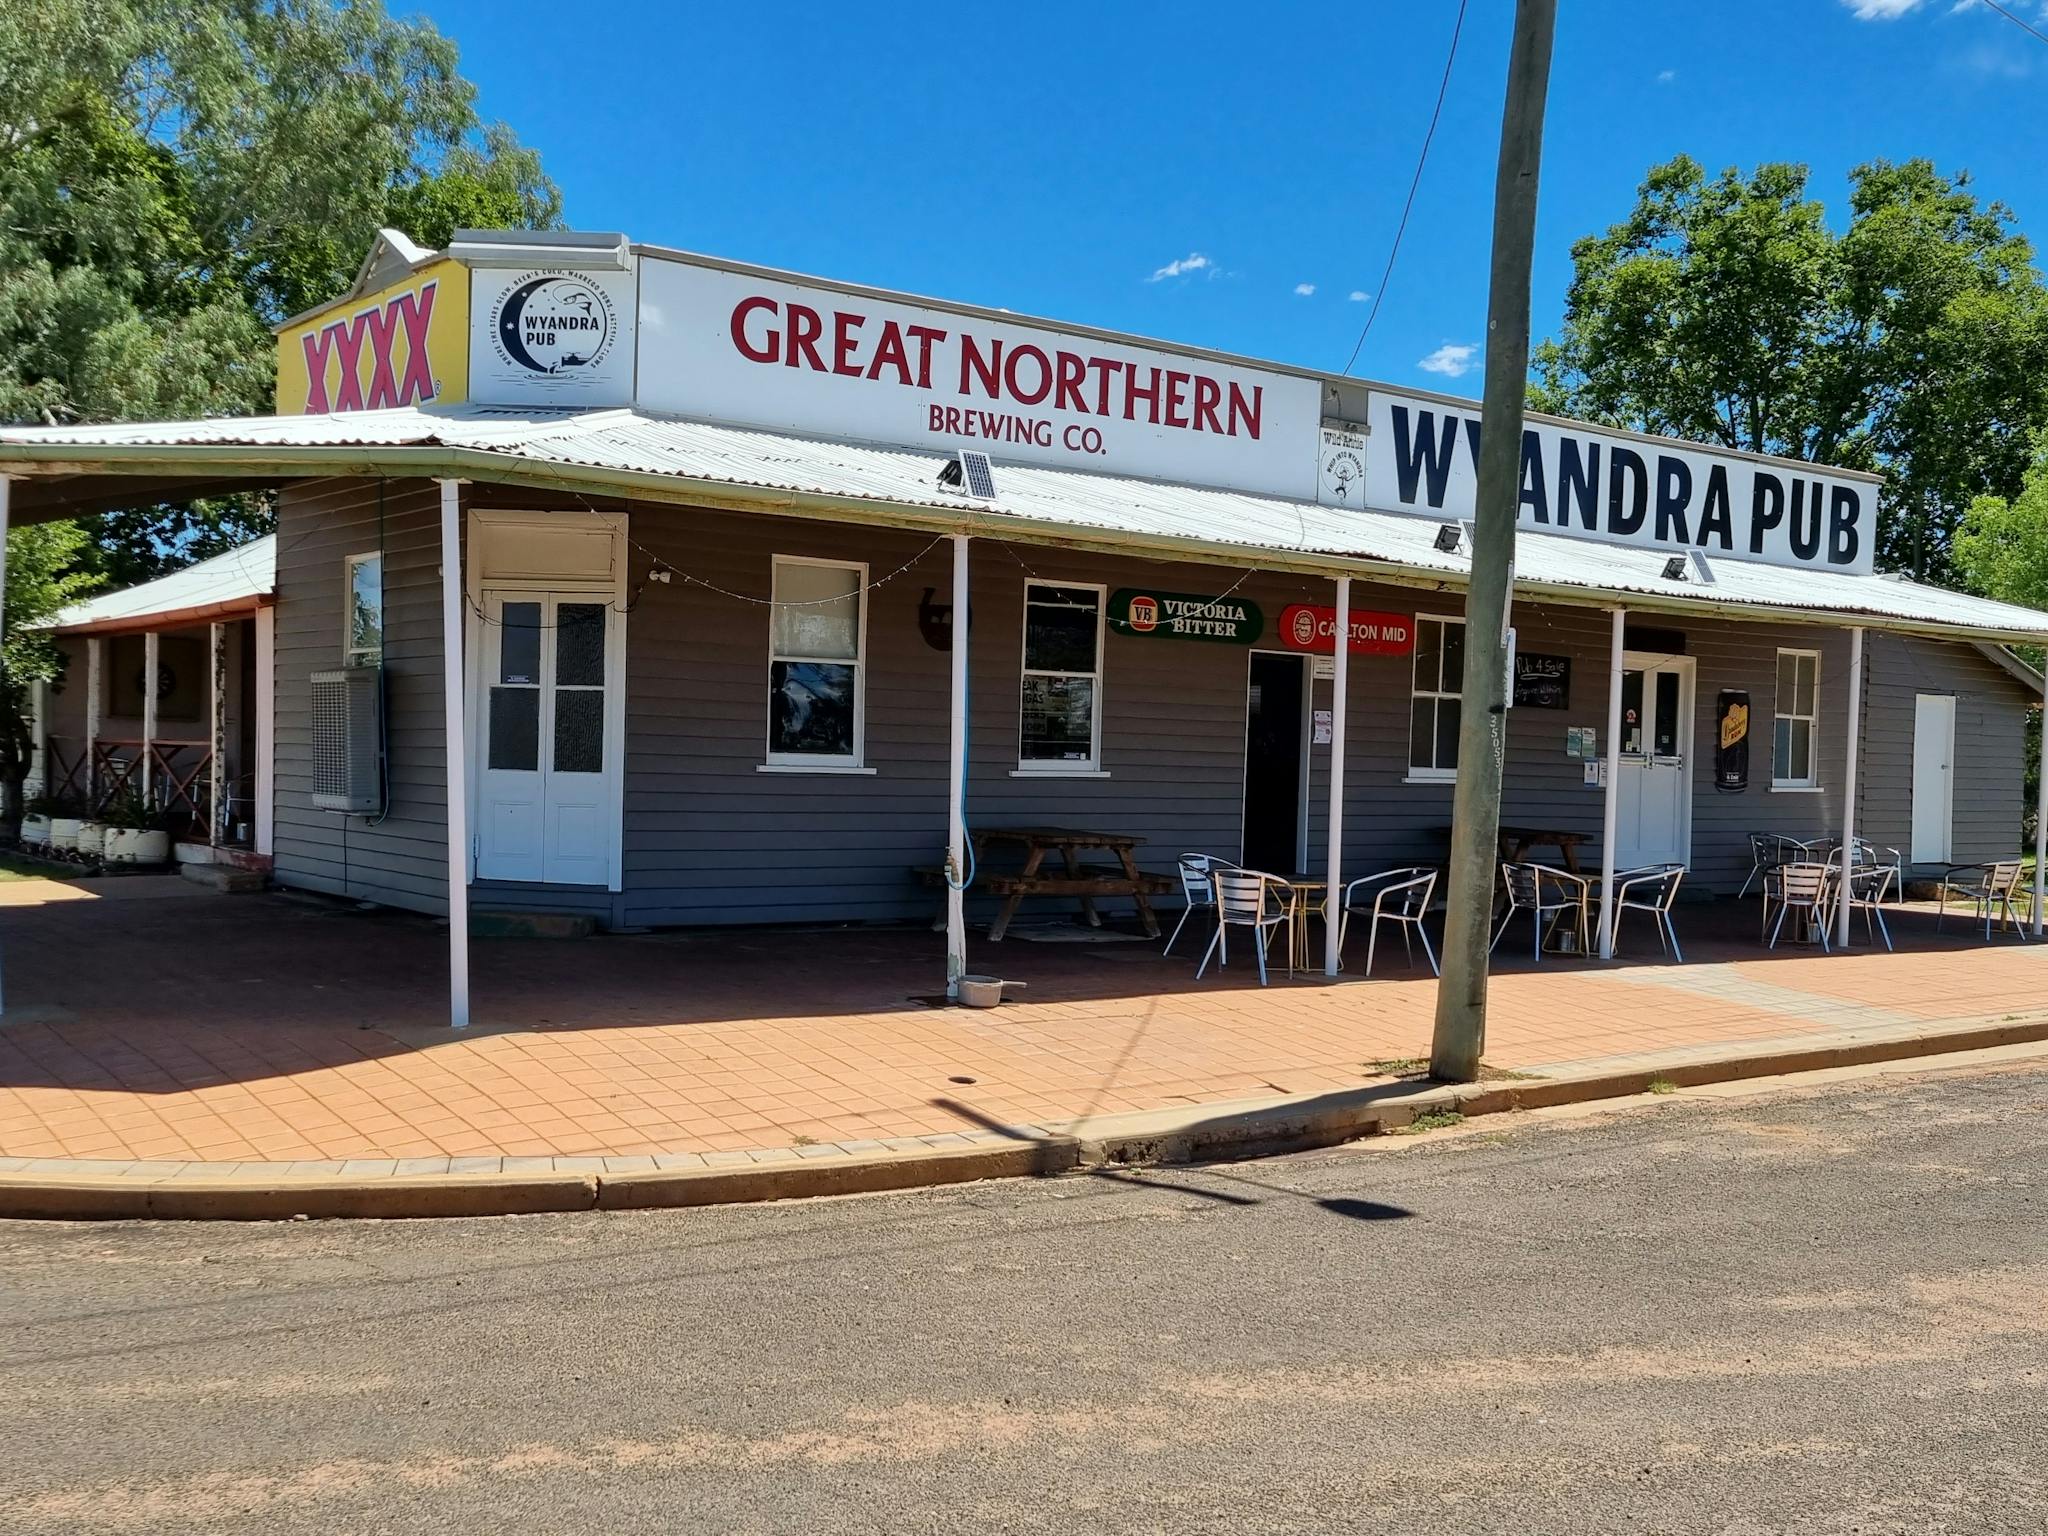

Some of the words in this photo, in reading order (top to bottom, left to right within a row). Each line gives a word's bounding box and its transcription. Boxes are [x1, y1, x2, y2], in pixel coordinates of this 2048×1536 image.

[568, 271, 600, 291] WARREGO
[490, 305, 499, 327] STARS
[525, 316, 599, 331] WYANDRA
[302, 279, 439, 415] XXXX
[490, 331, 498, 343] THE
[526, 332, 556, 346] PUB
[730, 296, 947, 390] GREAT
[959, 334, 1263, 440] NORTHERN
[929, 404, 1052, 447] BREWING
[1064, 424, 1107, 455] CO.
[1750, 472, 1860, 565] PUB
[1135, 607, 1152, 621] VB
[1163, 600, 1247, 621] VICTORIA
[1172, 618, 1237, 637] BITTER
[1318, 621, 1378, 640] CATON
[1382, 626, 1406, 642] MID
[1516, 657, 1532, 674] Pub
[1536, 659, 1542, 672] 4
[1544, 660, 1565, 672] Sale
